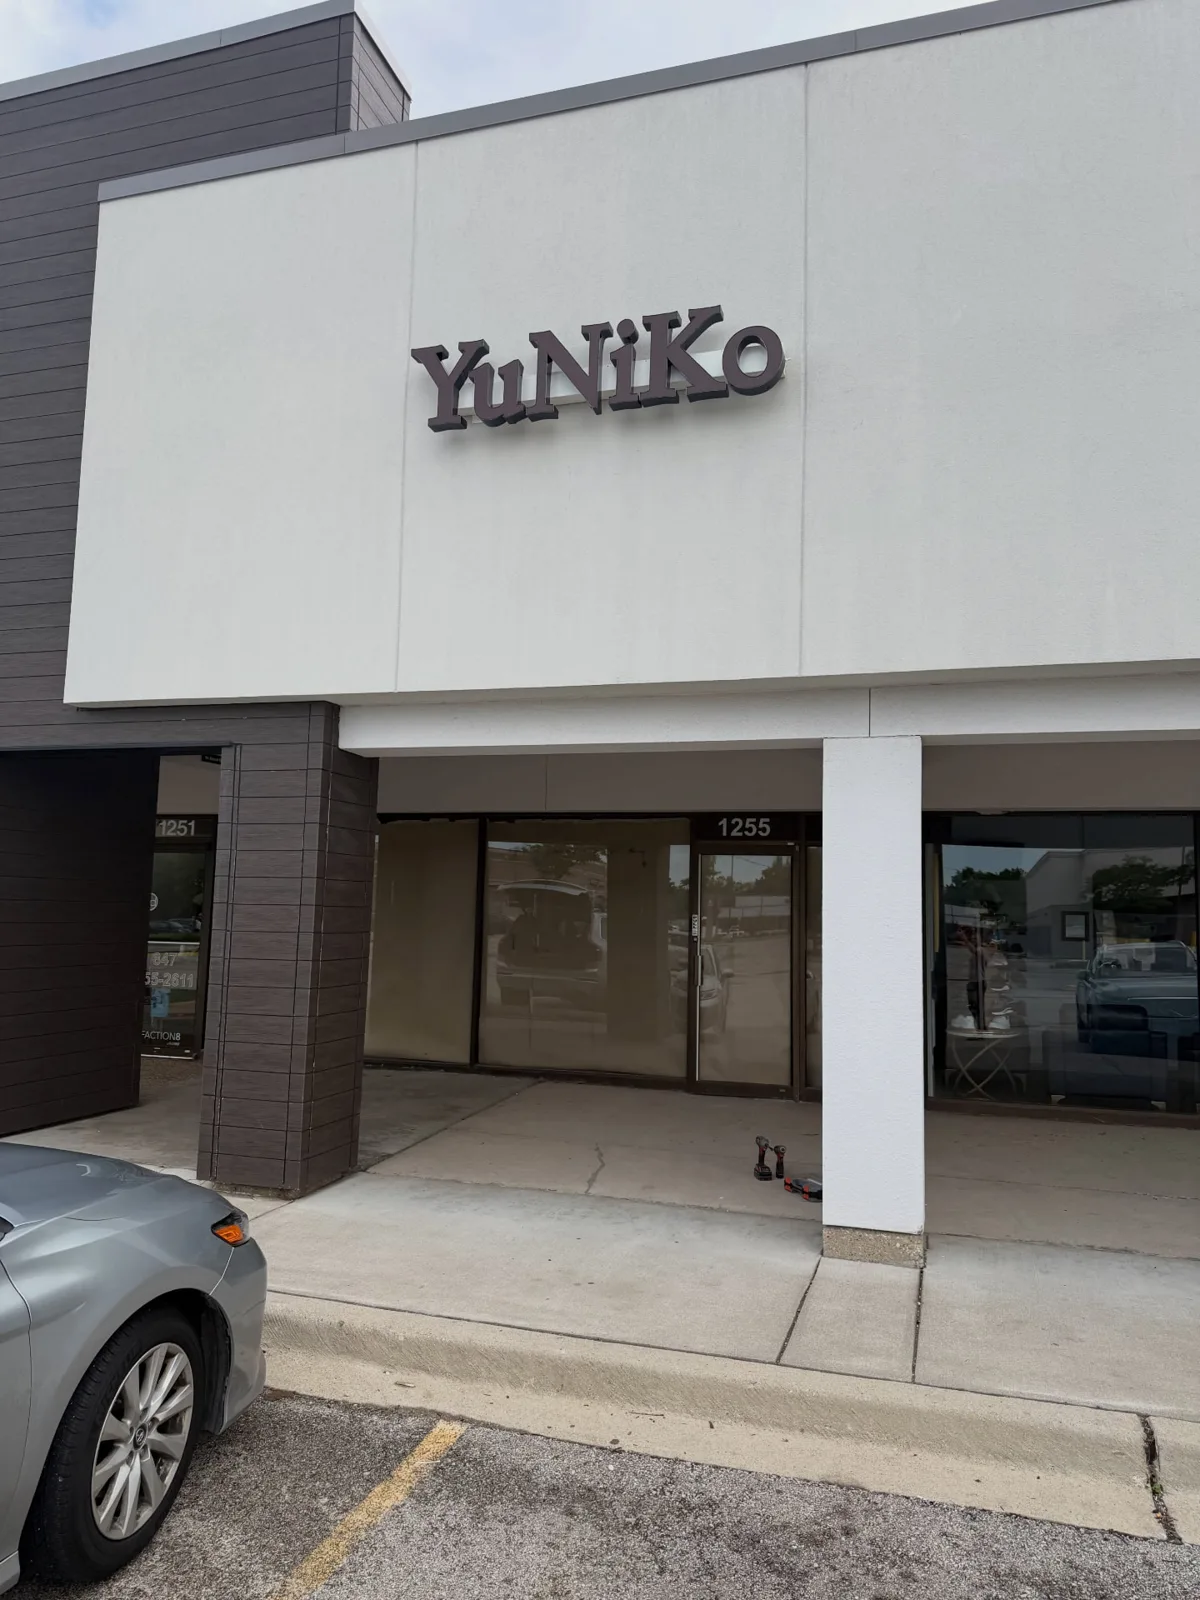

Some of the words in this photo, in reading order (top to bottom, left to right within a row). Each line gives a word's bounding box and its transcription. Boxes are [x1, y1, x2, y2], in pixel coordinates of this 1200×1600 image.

[411, 304, 785, 432] YuNiKo
[159, 819, 195, 837] 1251
[718, 817, 771, 837] 1255
